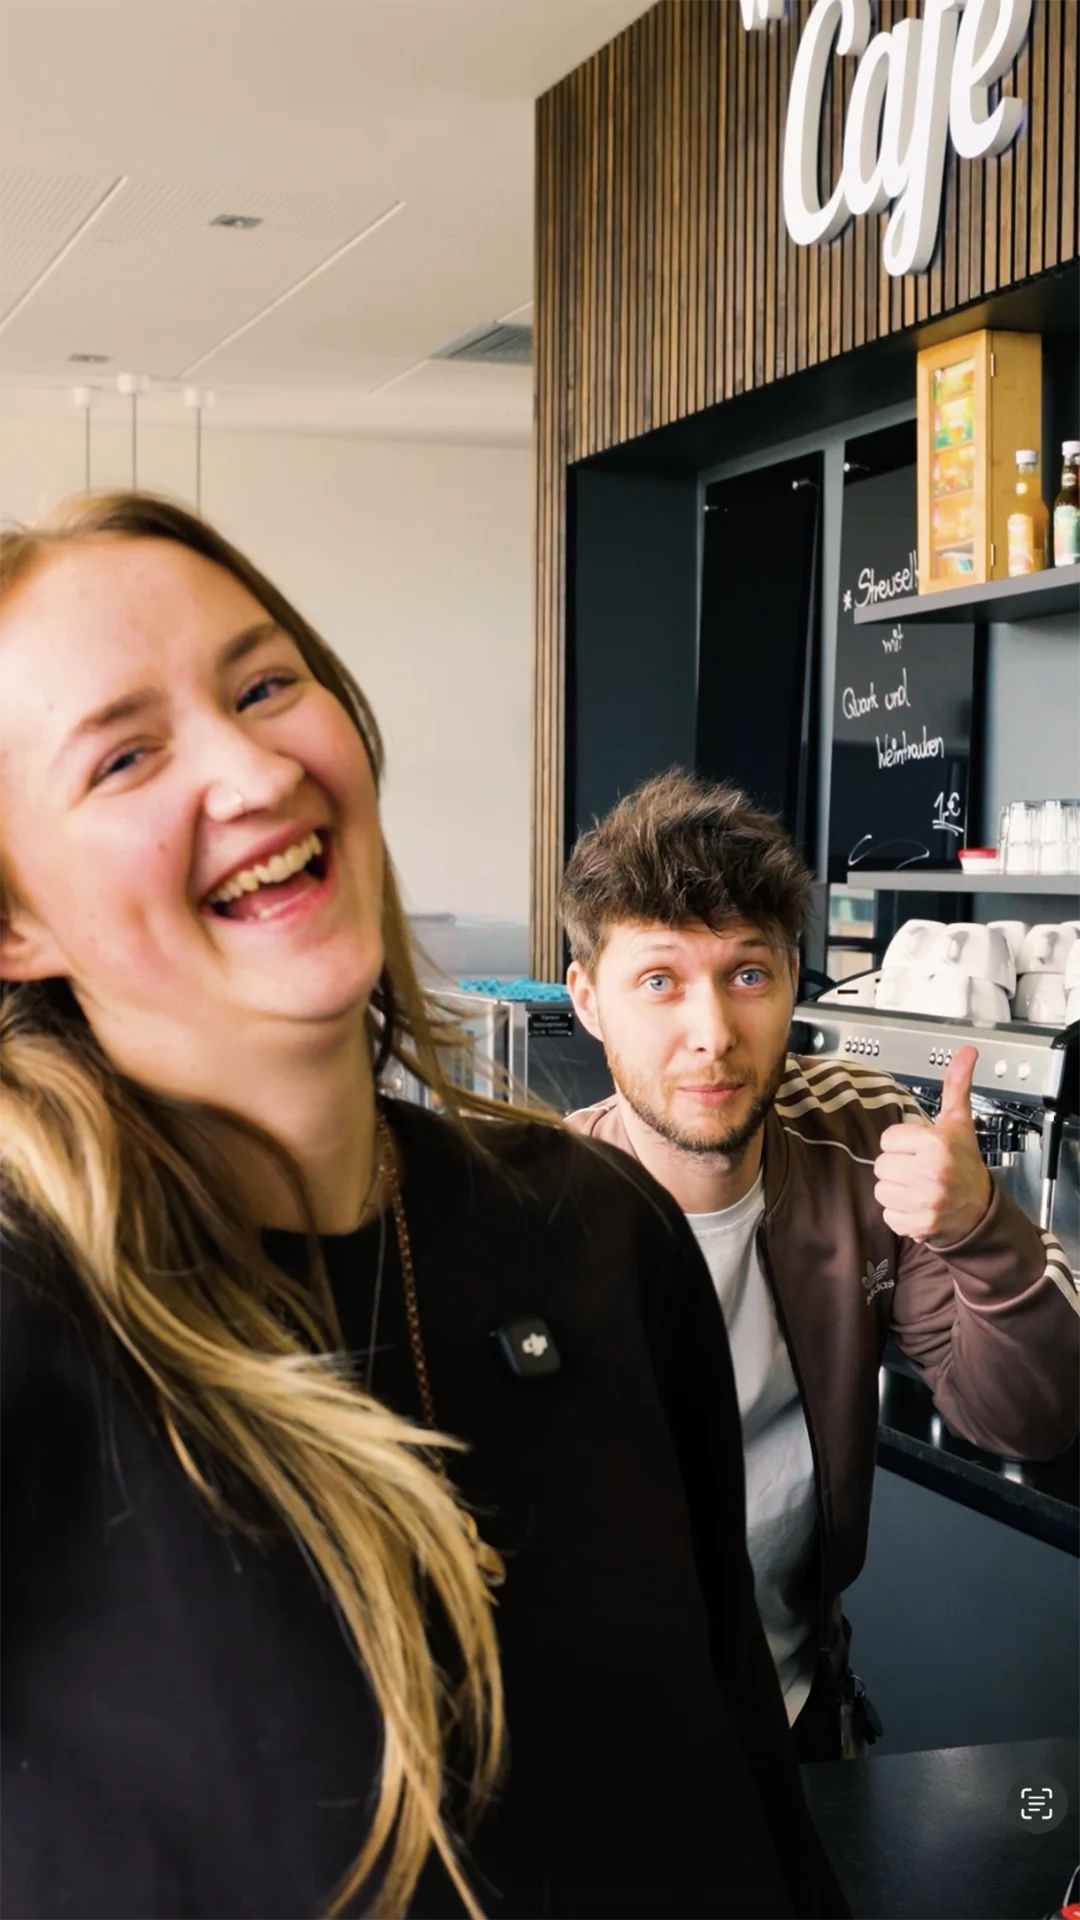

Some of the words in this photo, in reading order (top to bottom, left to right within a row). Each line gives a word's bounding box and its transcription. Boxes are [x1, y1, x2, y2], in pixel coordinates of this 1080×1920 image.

[882, 623, 904, 654] mit
[842, 681, 879, 719] Quark
[884, 667, 911, 711] und
[876, 725, 945, 769] Weintrauben
